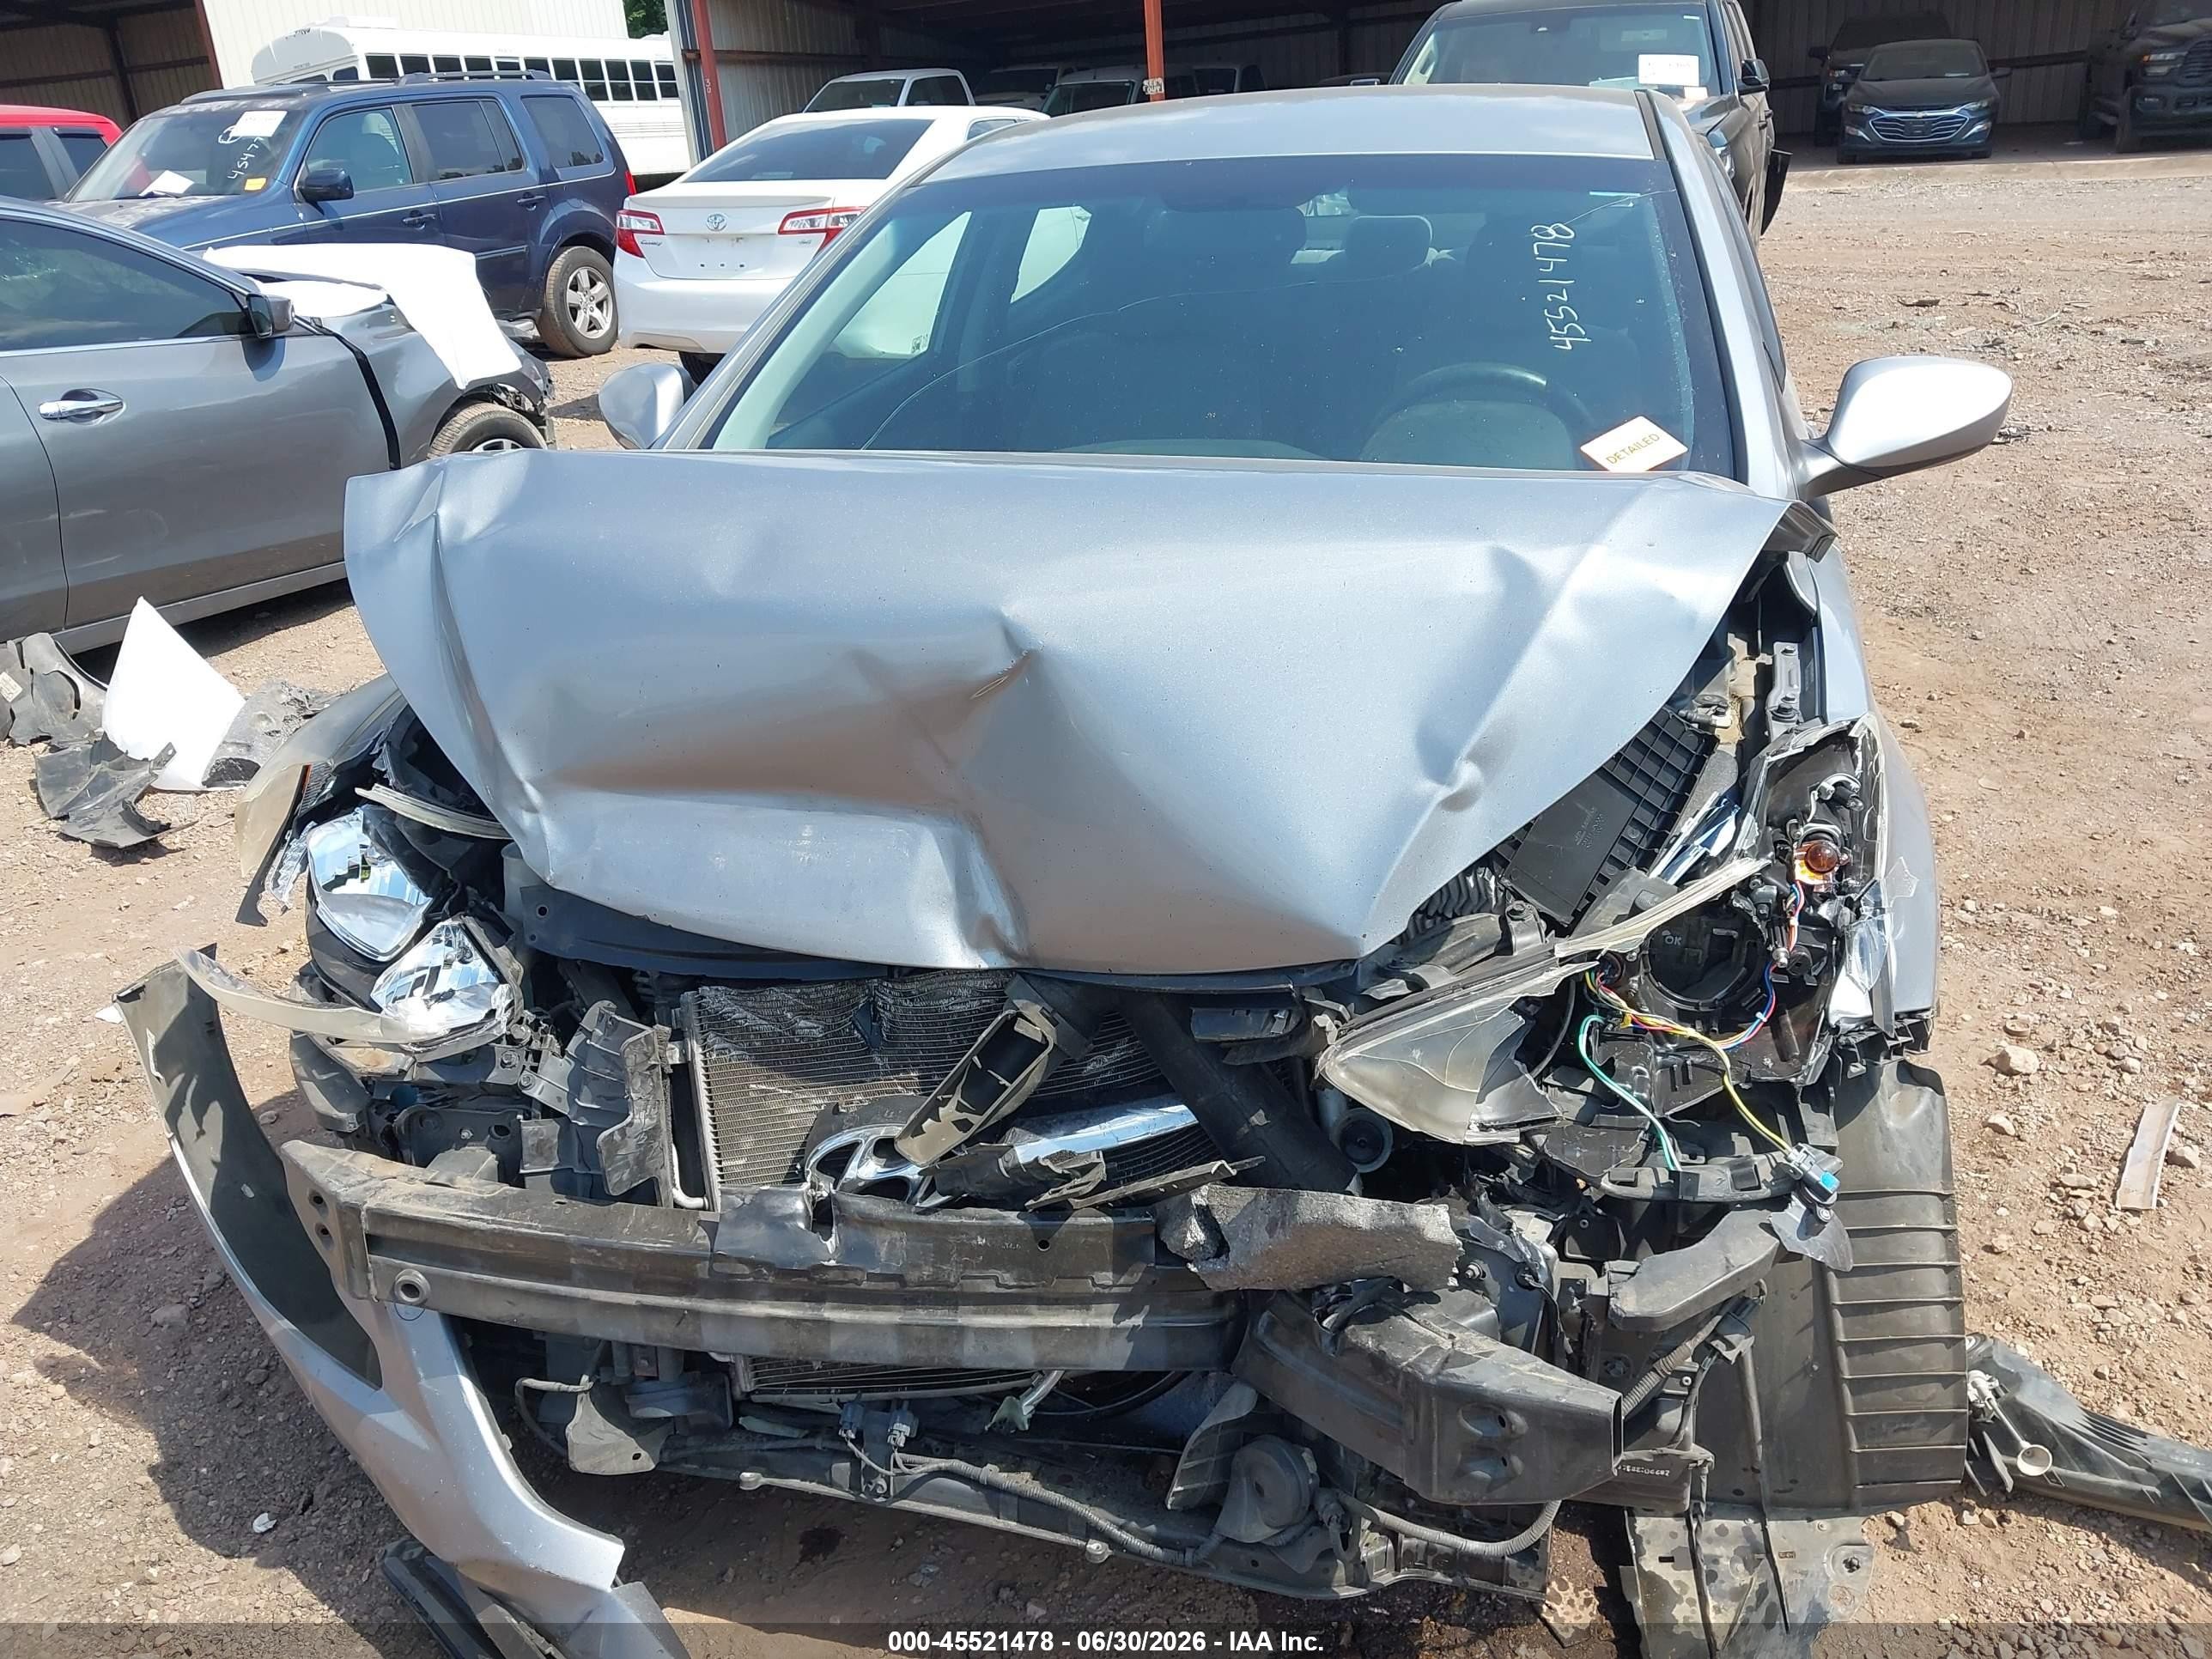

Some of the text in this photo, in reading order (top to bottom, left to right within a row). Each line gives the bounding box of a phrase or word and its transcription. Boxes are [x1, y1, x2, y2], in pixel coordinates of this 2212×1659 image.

[1530, 222, 1592, 350] 45521478
[1605, 433, 1661, 465] DETAILED
[1664, 935, 1682, 946] OK
